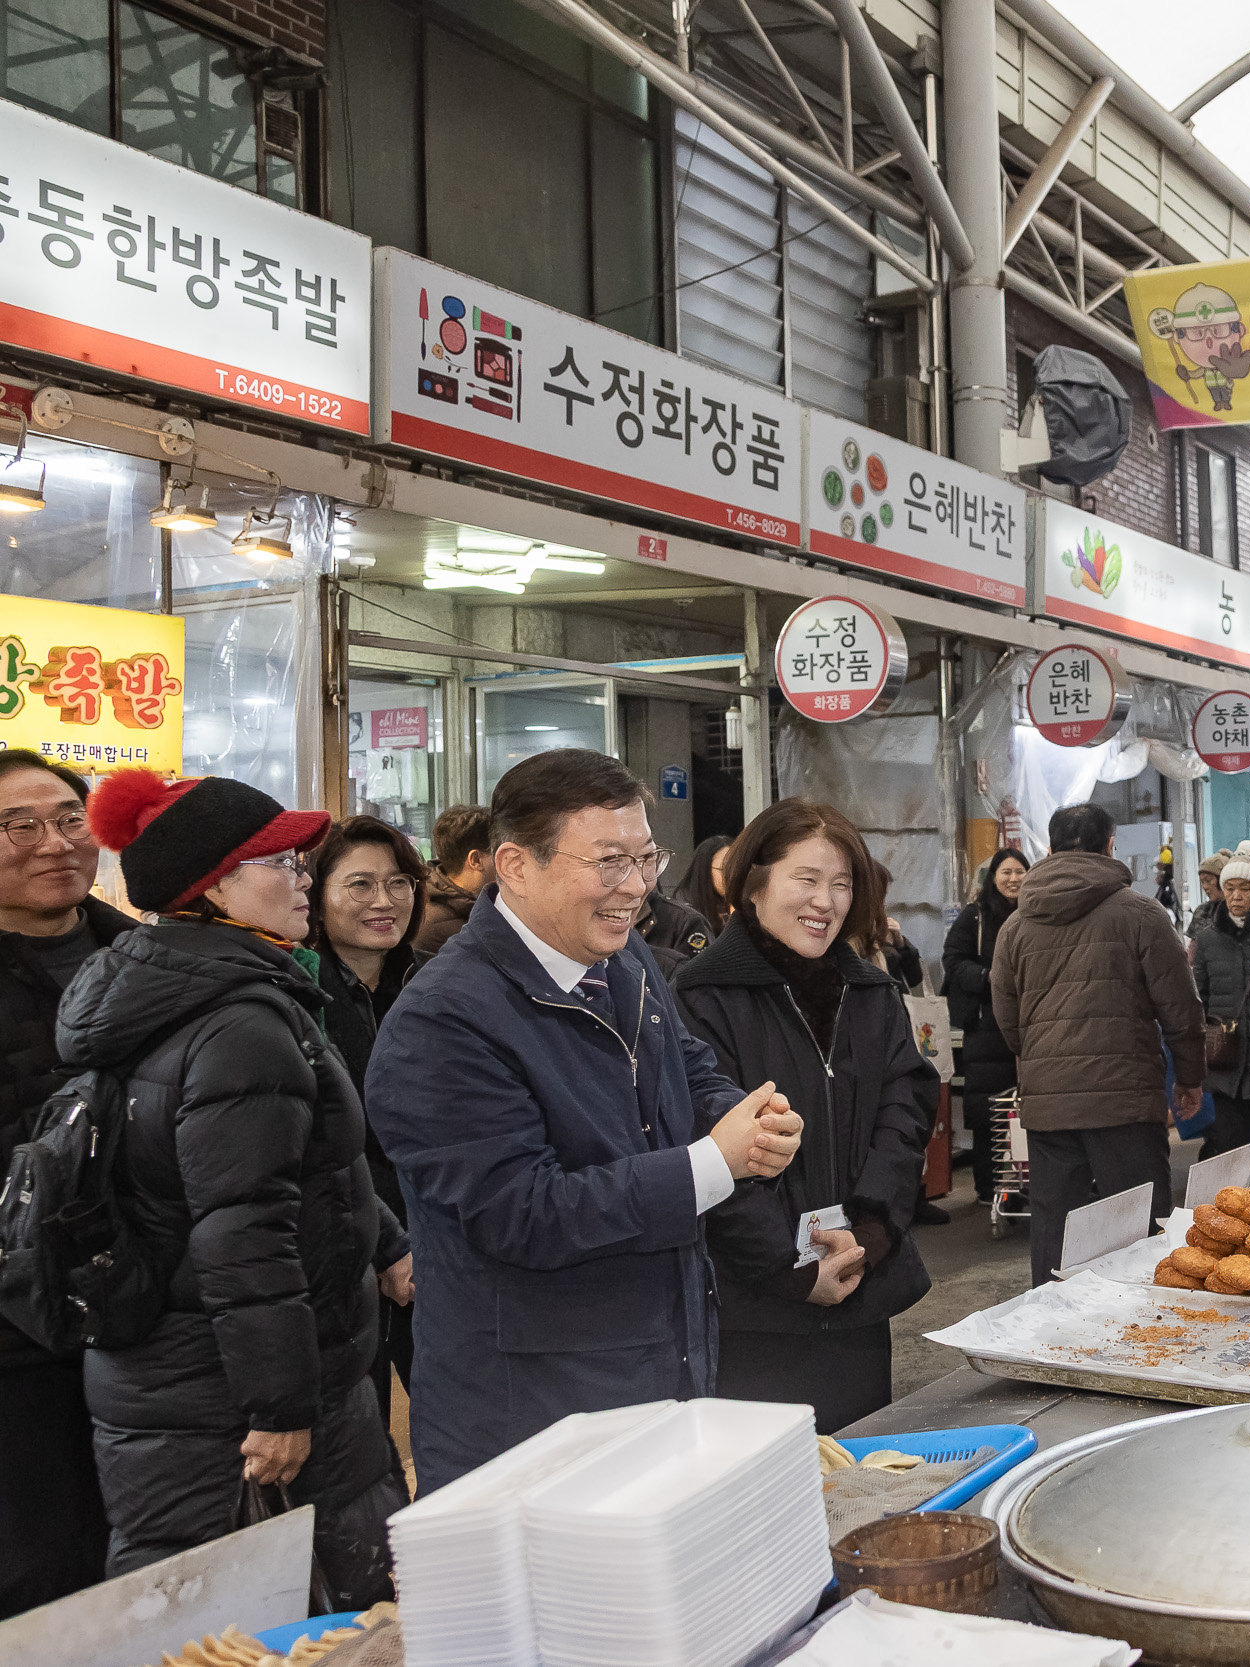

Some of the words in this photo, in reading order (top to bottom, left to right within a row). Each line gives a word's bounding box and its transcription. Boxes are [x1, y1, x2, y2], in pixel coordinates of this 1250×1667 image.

[215, 368, 343, 421] T.6409-1522
[543, 345, 785, 492] 수정화장품
[725, 508, 787, 538] T.456-8029
[903, 470, 1017, 560] 은혜반찬
[648, 538, 656, 553] 2
[805, 615, 856, 648] 수정
[792, 650, 872, 683] 화장품
[1048, 659, 1090, 688] 은혜
[38, 646, 182, 730] 족발
[813, 694, 852, 711] 화장품
[1049, 687, 1092, 716] 반찬
[1211, 702, 1249, 726] 농촌
[41, 742, 149, 763] 포장판매합니다
[1212, 728, 1249, 748] 야채
